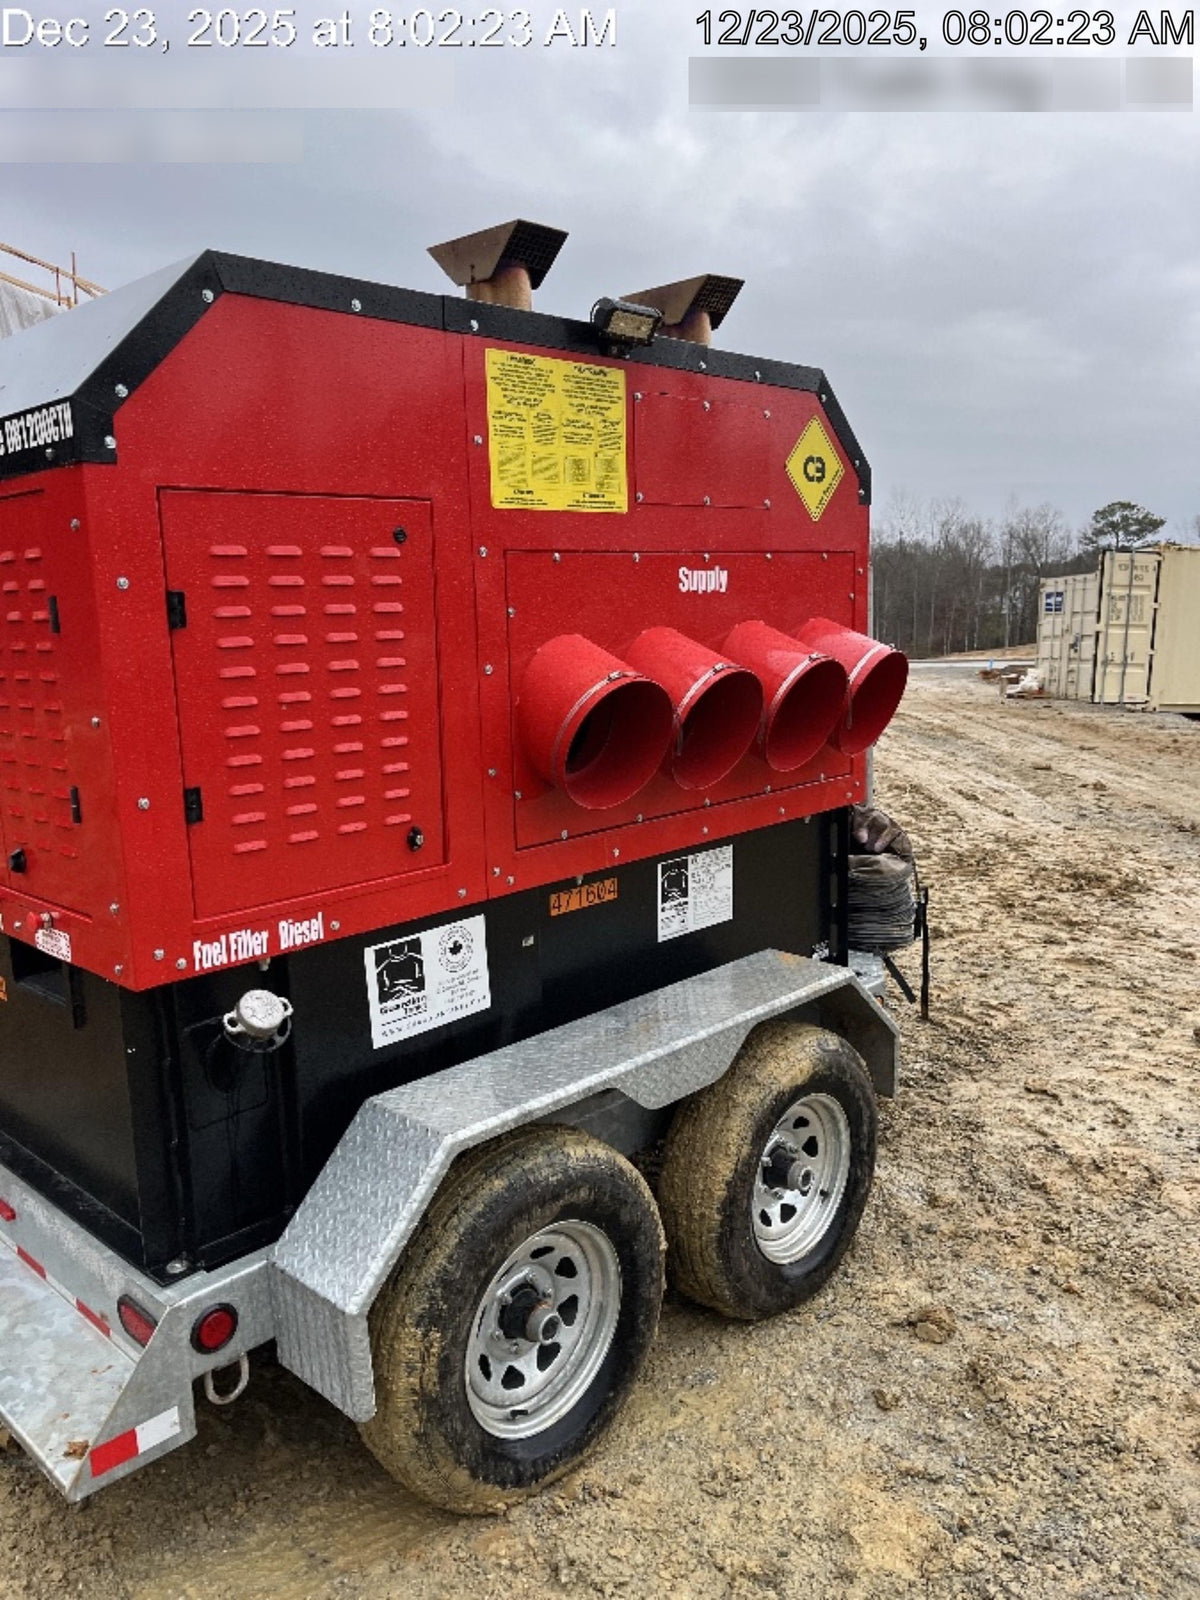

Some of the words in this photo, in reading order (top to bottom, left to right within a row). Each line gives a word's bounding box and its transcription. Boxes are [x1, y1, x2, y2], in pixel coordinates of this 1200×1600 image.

[803, 455, 826, 483] C3
[678, 565, 728, 594] Supply
[552, 880, 616, 912] 471604
[193, 934, 228, 971] Fuel
[229, 929, 269, 962] Filler
[278, 912, 324, 950] Diesel
